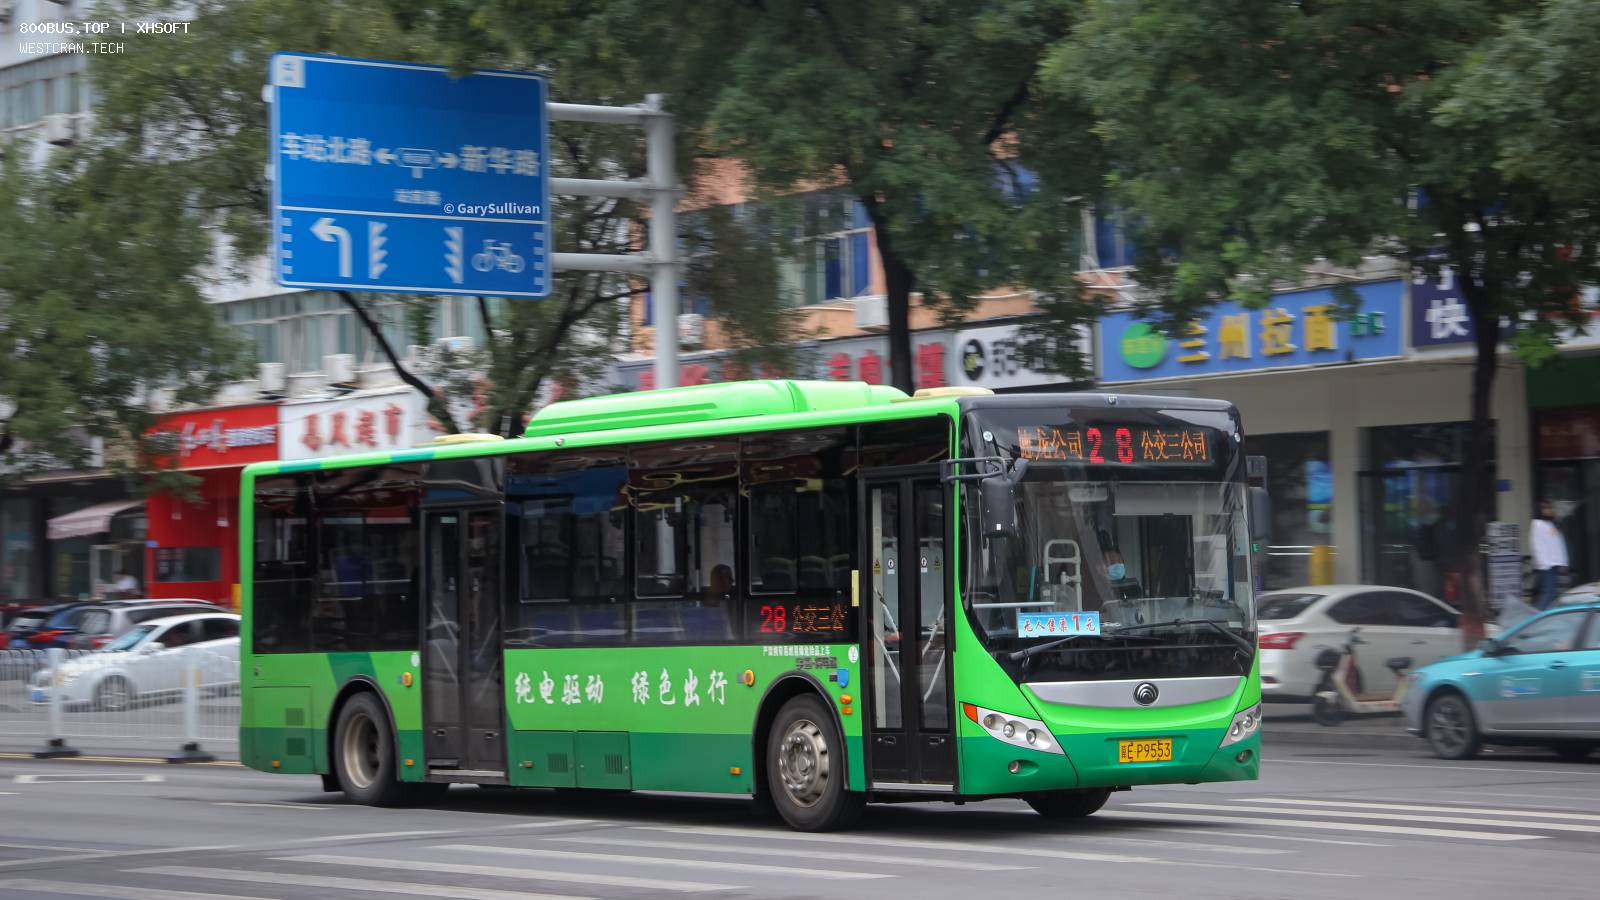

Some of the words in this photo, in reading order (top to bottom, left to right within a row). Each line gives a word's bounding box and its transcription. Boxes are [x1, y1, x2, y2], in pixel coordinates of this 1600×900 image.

[281, 131, 372, 166] 车站北路
[460, 145, 540, 177] 新华路
[1177, 304, 1339, 363] 兰州拉面
[1424, 298, 1470, 339] 快
[1142, 429, 1207, 461] 公交三公司
[759, 605, 787, 633] 28
[793, 604, 846, 632] 公交三公
[514, 671, 604, 705] 纯电驱动
[631, 668, 728, 707] 绿色出行
